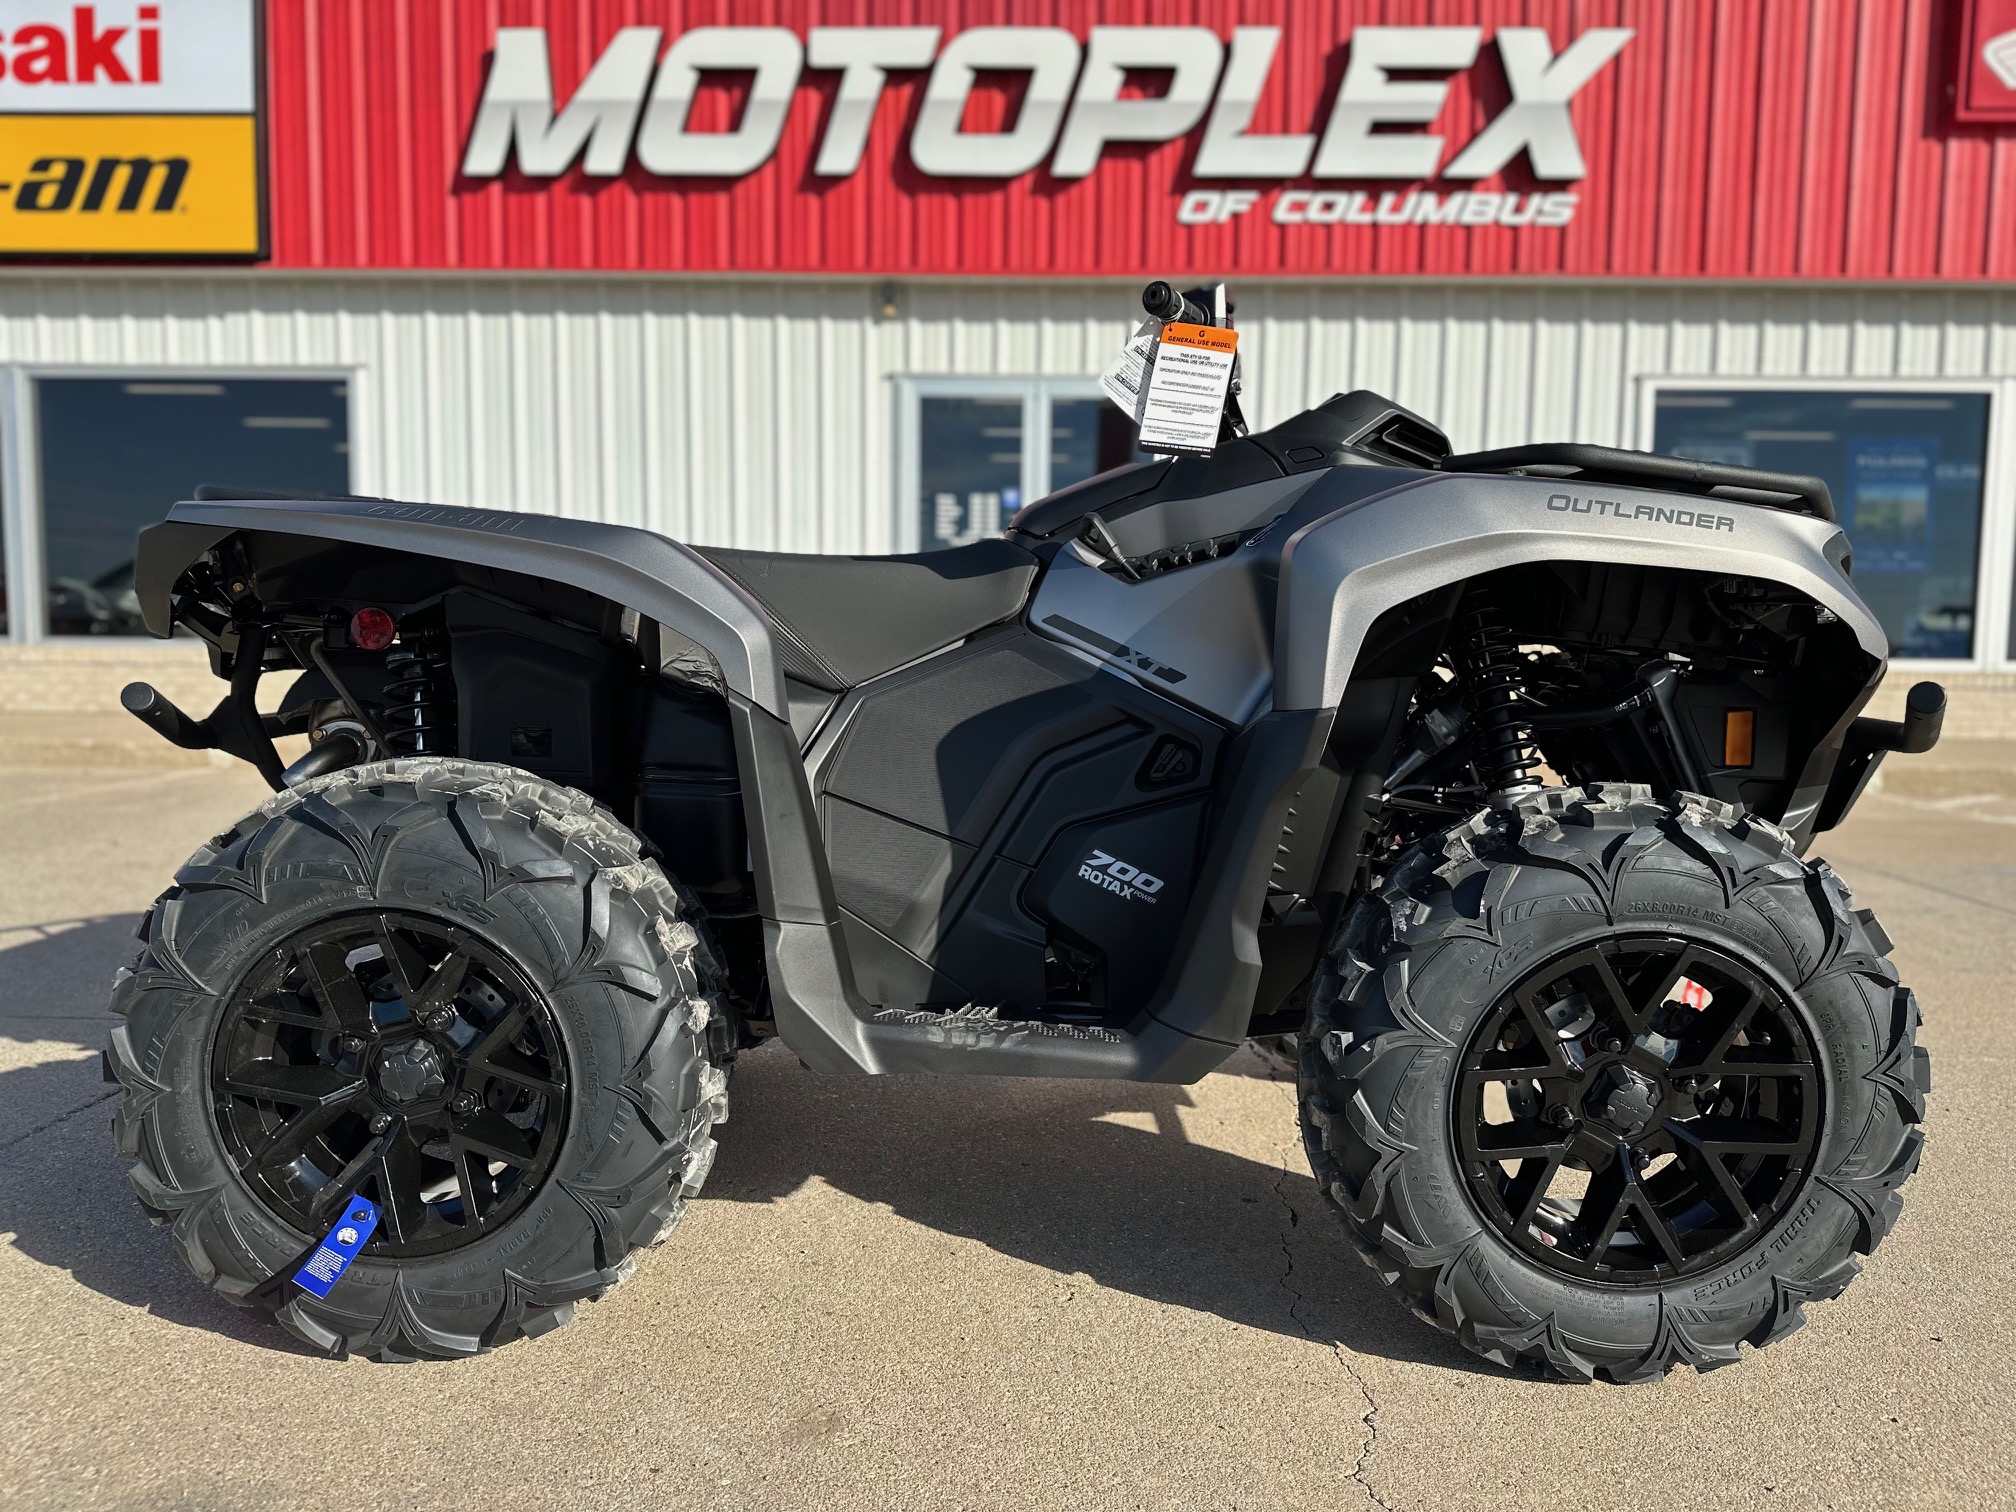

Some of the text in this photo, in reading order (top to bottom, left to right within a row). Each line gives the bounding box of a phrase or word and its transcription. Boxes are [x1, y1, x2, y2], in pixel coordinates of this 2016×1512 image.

[0, 5, 160, 84] aki
[461, 26, 1637, 180] MOTOPLEX
[1177, 190, 1579, 227] OF COLUMBUS
[1168, 335, 1196, 344] GENERAL
[1210, 340, 1232, 348] MODEL
[1546, 494, 1735, 532] OUTLANDER
[1118, 646, 1170, 674] XT
[1078, 864, 1156, 904] ROTAX POWER
[1084, 848, 1164, 894] 700
[435, 890, 500, 924] XPS
[1627, 901, 1700, 918] 26X8.00R14
[1702, 908, 1732, 926] MST
[1692, 1198, 1822, 1302] TRAIL FORCE
